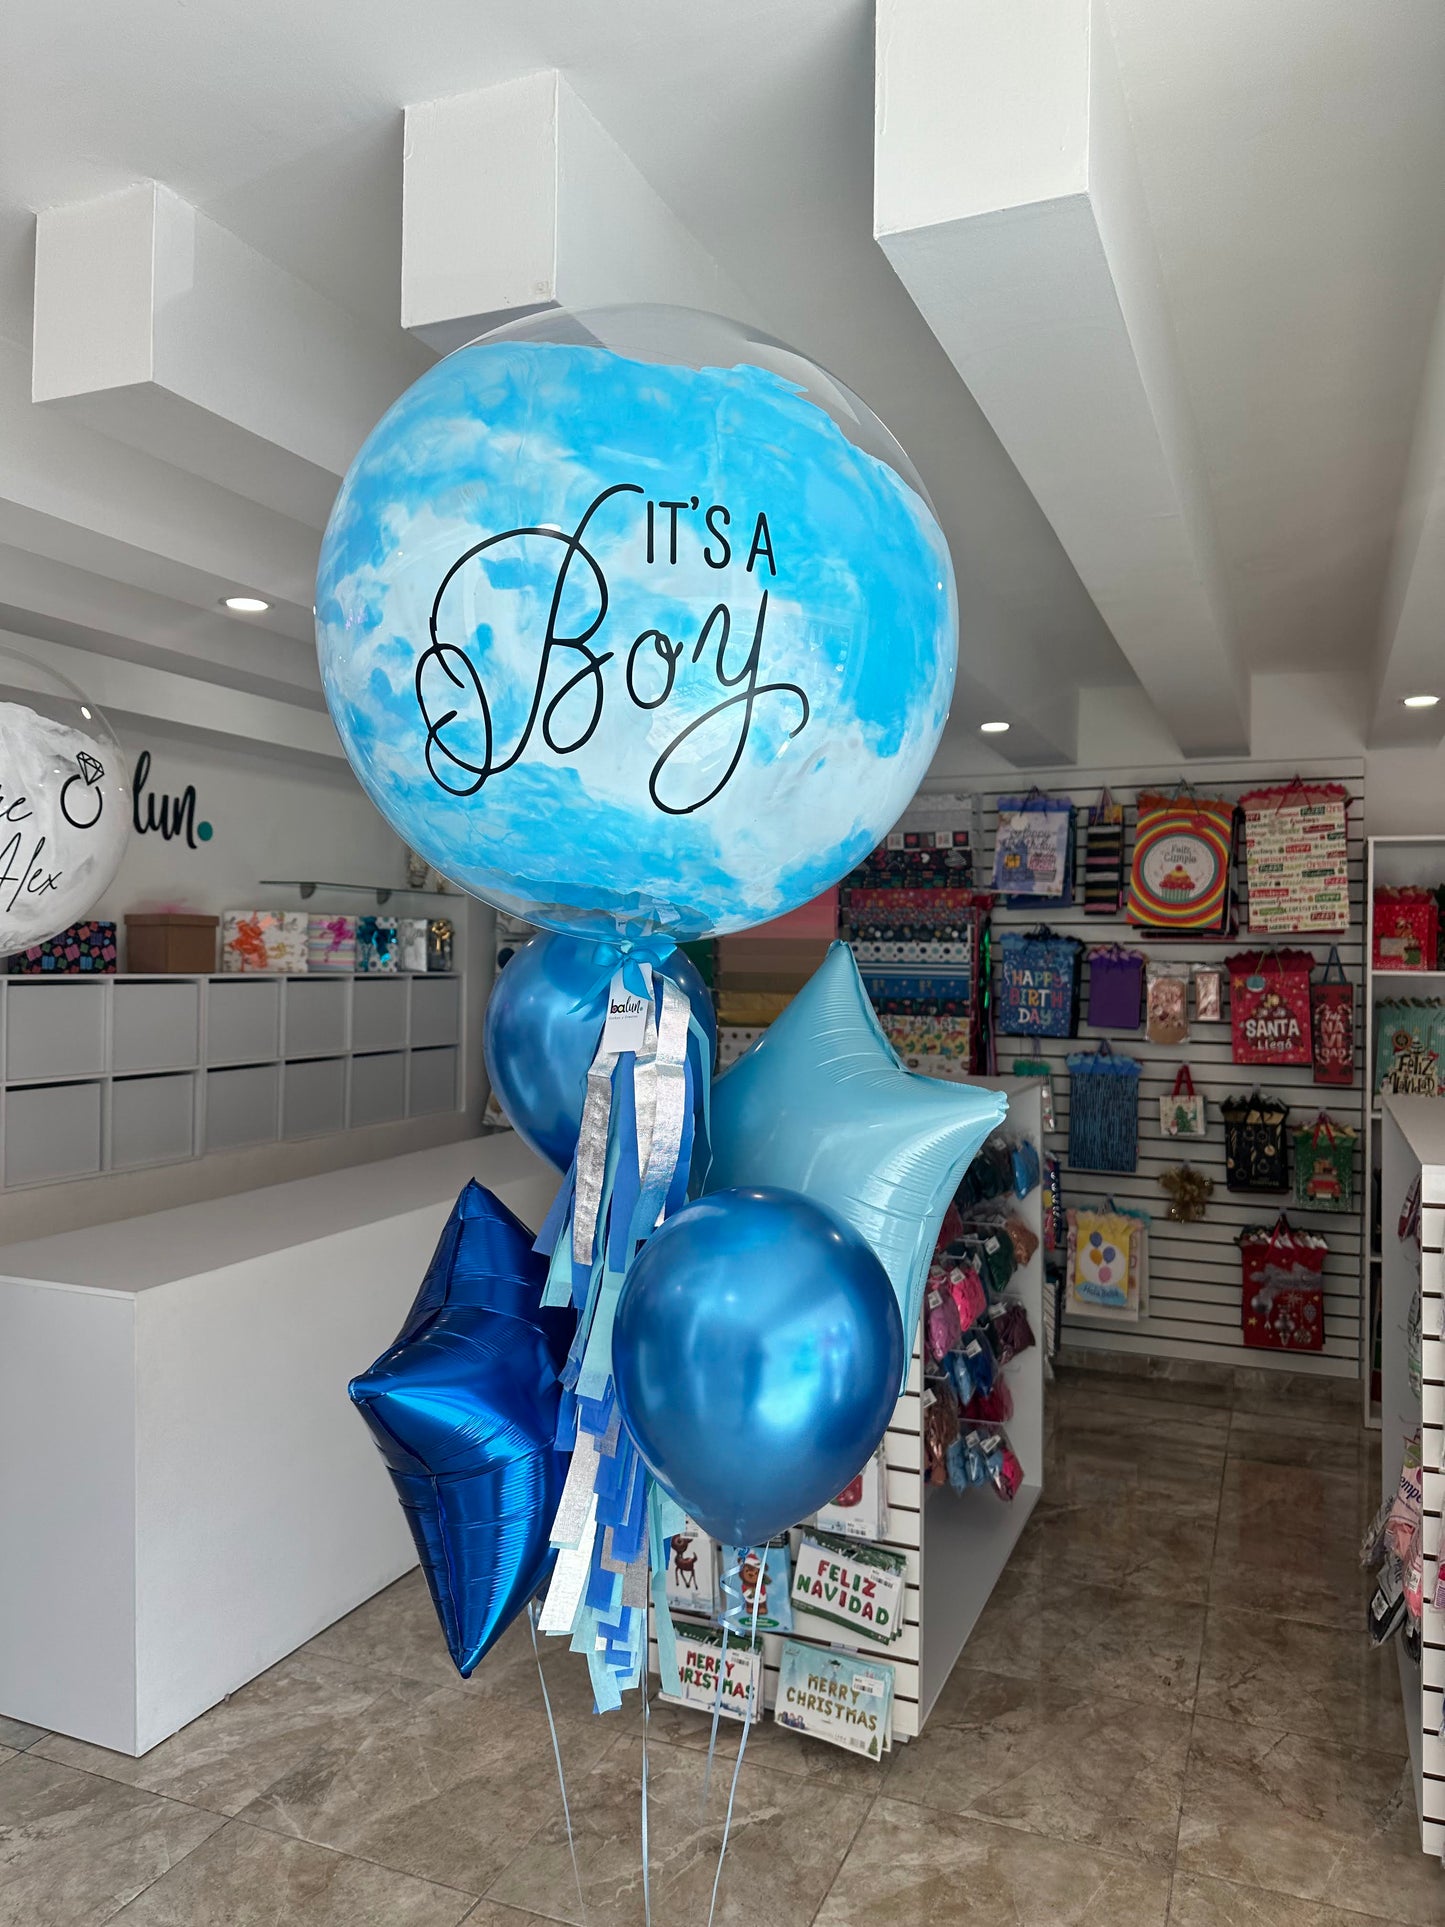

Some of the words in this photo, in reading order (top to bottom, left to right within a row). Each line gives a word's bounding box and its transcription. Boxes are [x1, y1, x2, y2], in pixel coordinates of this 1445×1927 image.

[646, 495, 732, 570] IT'S
[745, 511, 777, 577] A
[415, 483, 810, 815] Boy
[1011, 968, 1063, 989] HAPPY
[1009, 987, 1064, 1008] BIRTH
[1018, 1007, 1052, 1026] DAY
[1245, 1018, 1300, 1038] SANTA
[817, 1559, 877, 1599] FELIZ
[796, 1573, 890, 1626] NAVIDAD
[807, 1673, 860, 1705] MERRY
[786, 1686, 878, 1732] CHRISTMAS
